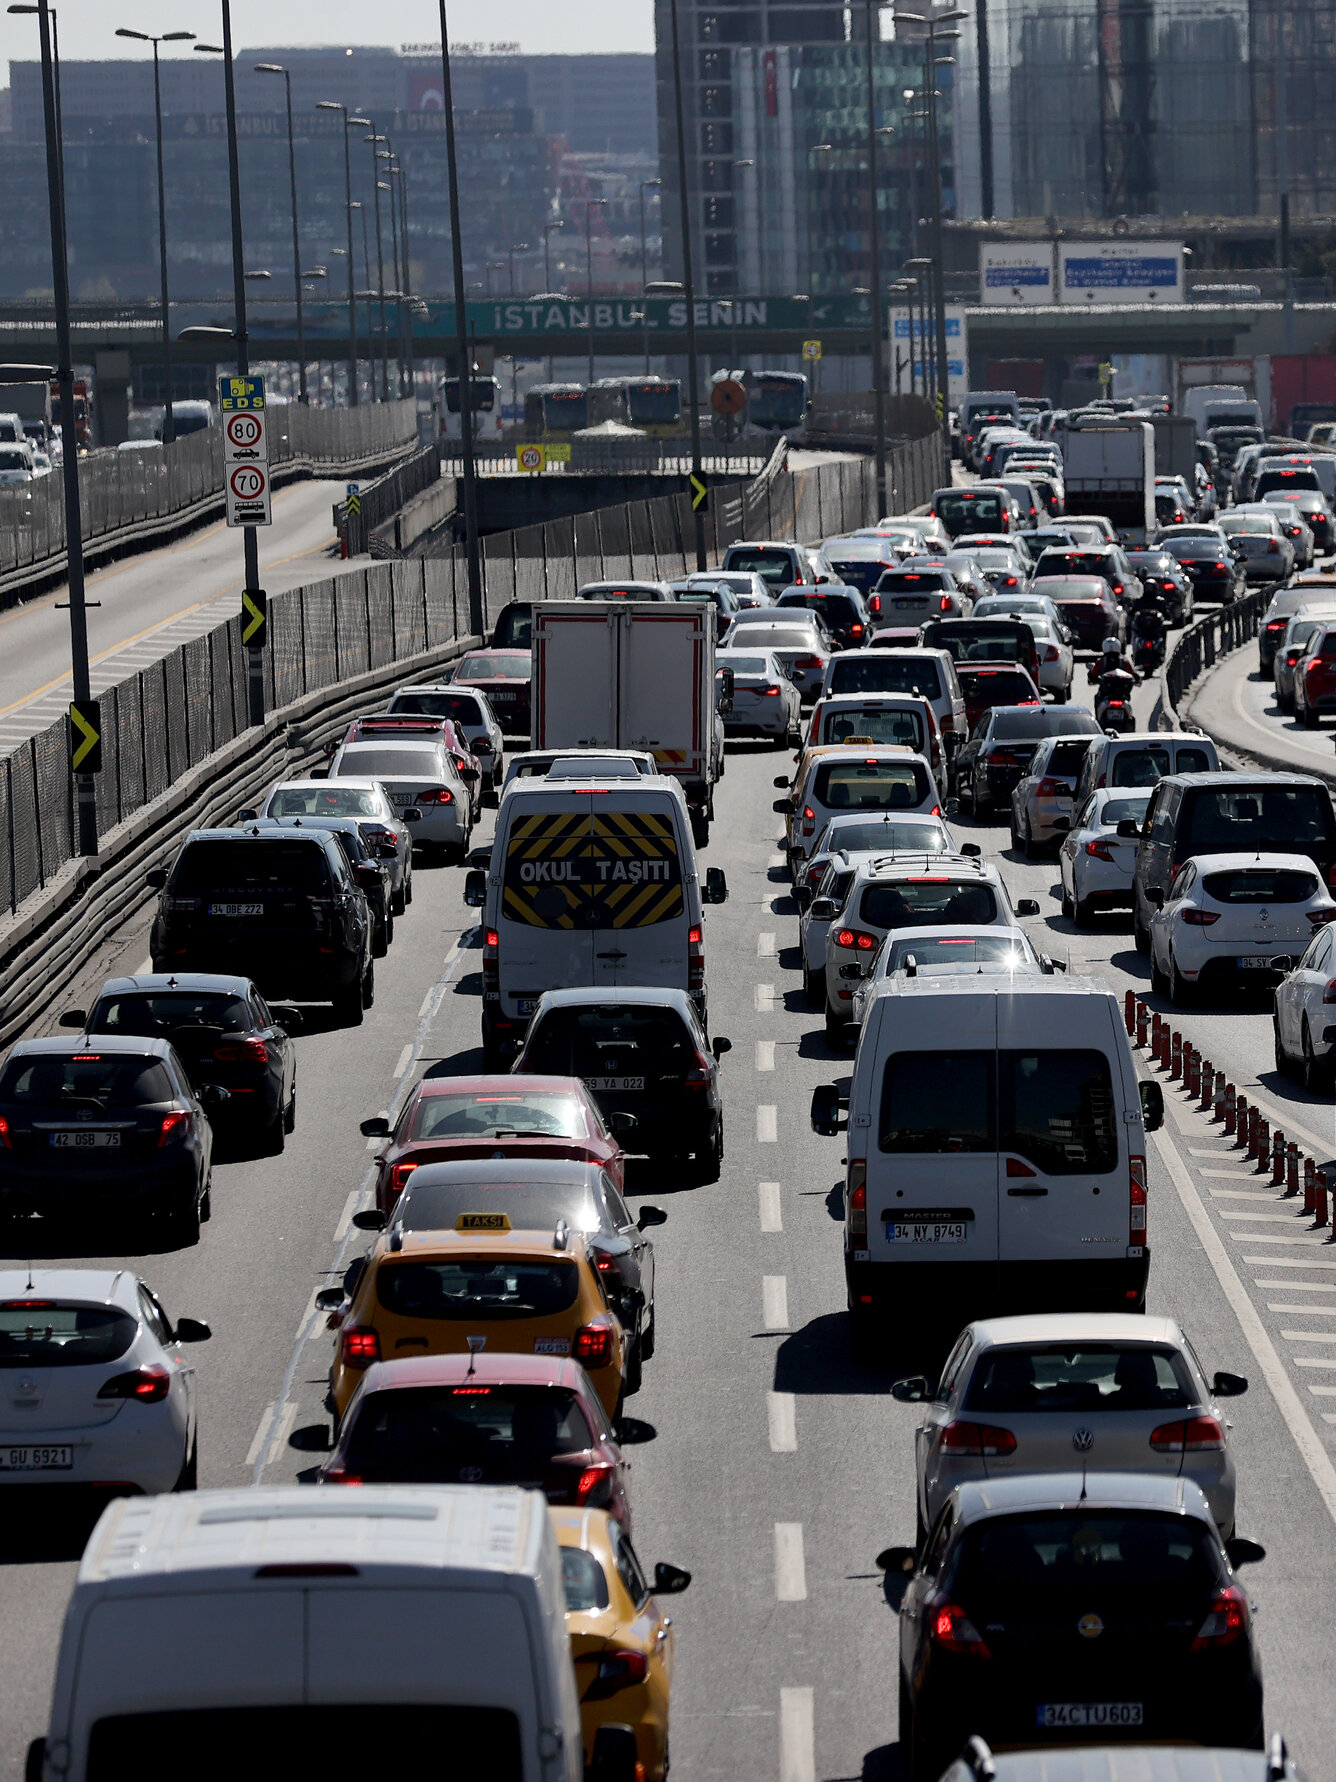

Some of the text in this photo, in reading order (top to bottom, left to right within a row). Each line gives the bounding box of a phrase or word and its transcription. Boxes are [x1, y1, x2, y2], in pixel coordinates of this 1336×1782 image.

[223, 397, 264, 408] EDS
[234, 423, 255, 438] 80
[238, 475, 259, 490] 70
[520, 860, 670, 884] OKUL TAŞITI
[212, 905, 223, 914] 34
[244, 904, 262, 914] 272
[1243, 958, 1253, 968] 34
[585, 1078, 643, 1090] 59 YA 022
[55, 1132, 119, 1145] 42 DSB 75
[904, 1212, 952, 1220] MASTER
[895, 1225, 963, 1239] 34 NY 8749
[10, 1449, 67, 1464] GU 6921
